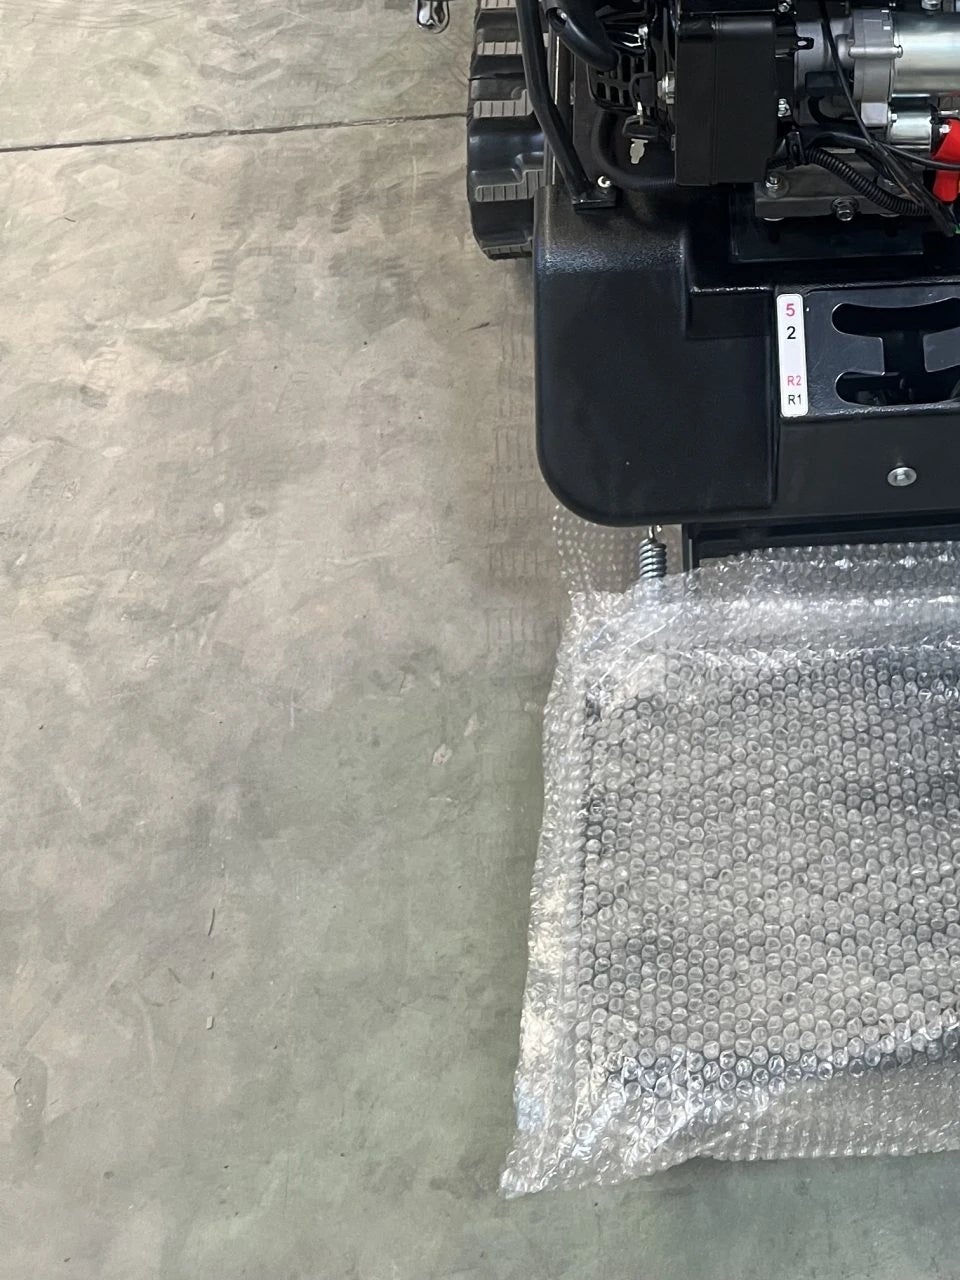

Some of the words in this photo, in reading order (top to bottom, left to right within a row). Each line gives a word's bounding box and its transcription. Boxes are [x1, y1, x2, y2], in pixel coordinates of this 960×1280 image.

[785, 303, 796, 317] 5
[786, 325, 797, 340] 2
[787, 375, 802, 387] R2
[787, 394, 802, 406] R1
